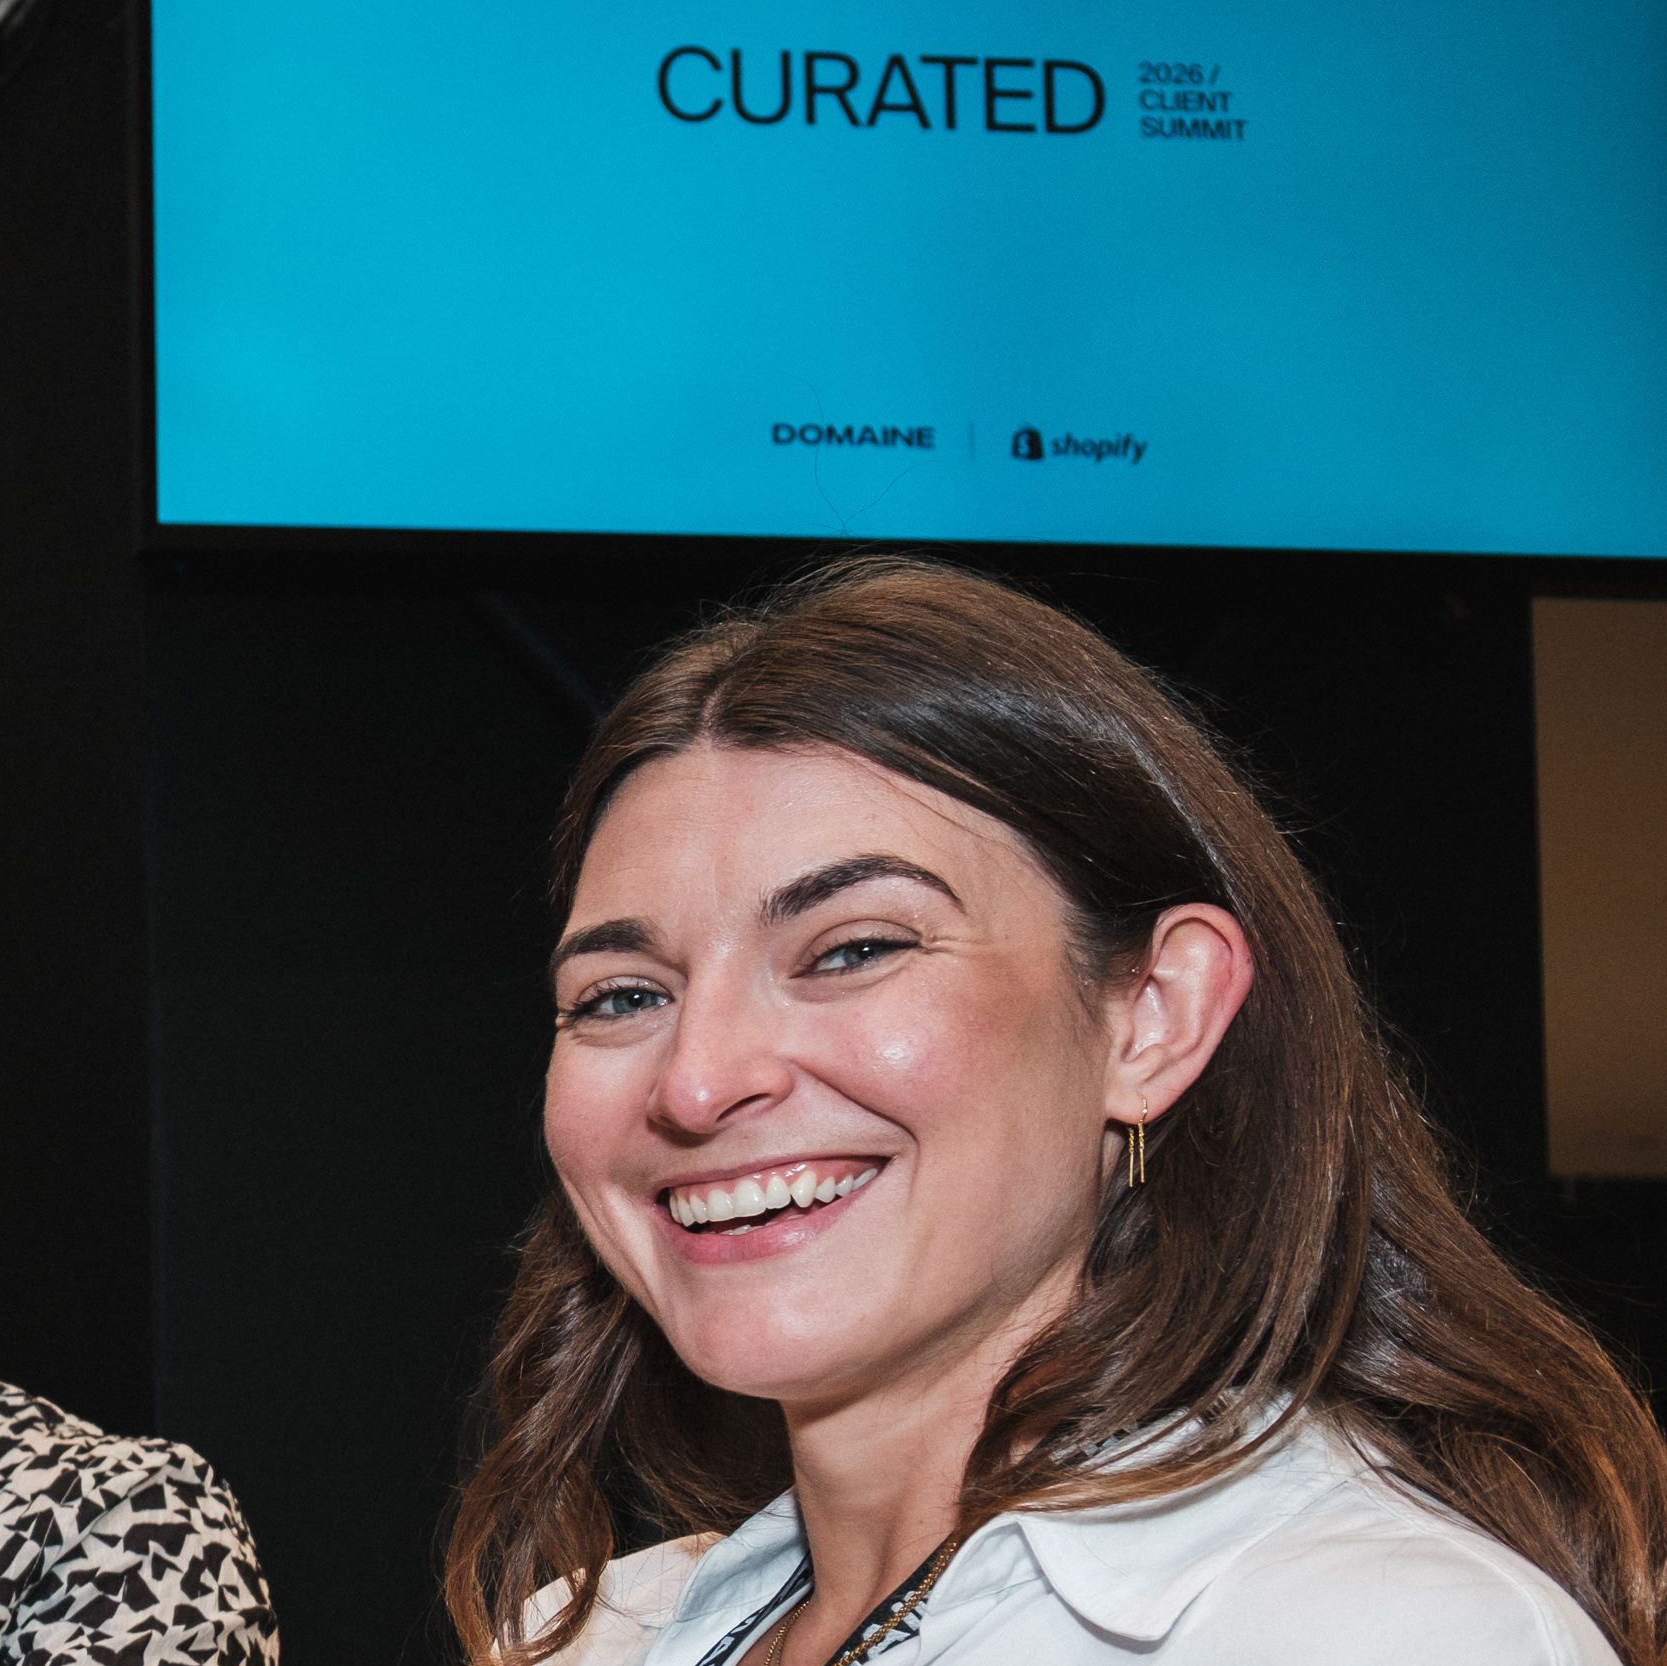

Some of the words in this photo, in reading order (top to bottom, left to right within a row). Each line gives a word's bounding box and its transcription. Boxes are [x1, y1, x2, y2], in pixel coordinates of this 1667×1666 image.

[1138, 62, 1204, 85] 2026
[655, 44, 1109, 138] CURATED
[1138, 89, 1232, 113] CLIENT
[1140, 116, 1247, 141] SUMMIT
[770, 422, 936, 450] DOMAINE
[1050, 431, 1150, 466] shopify
